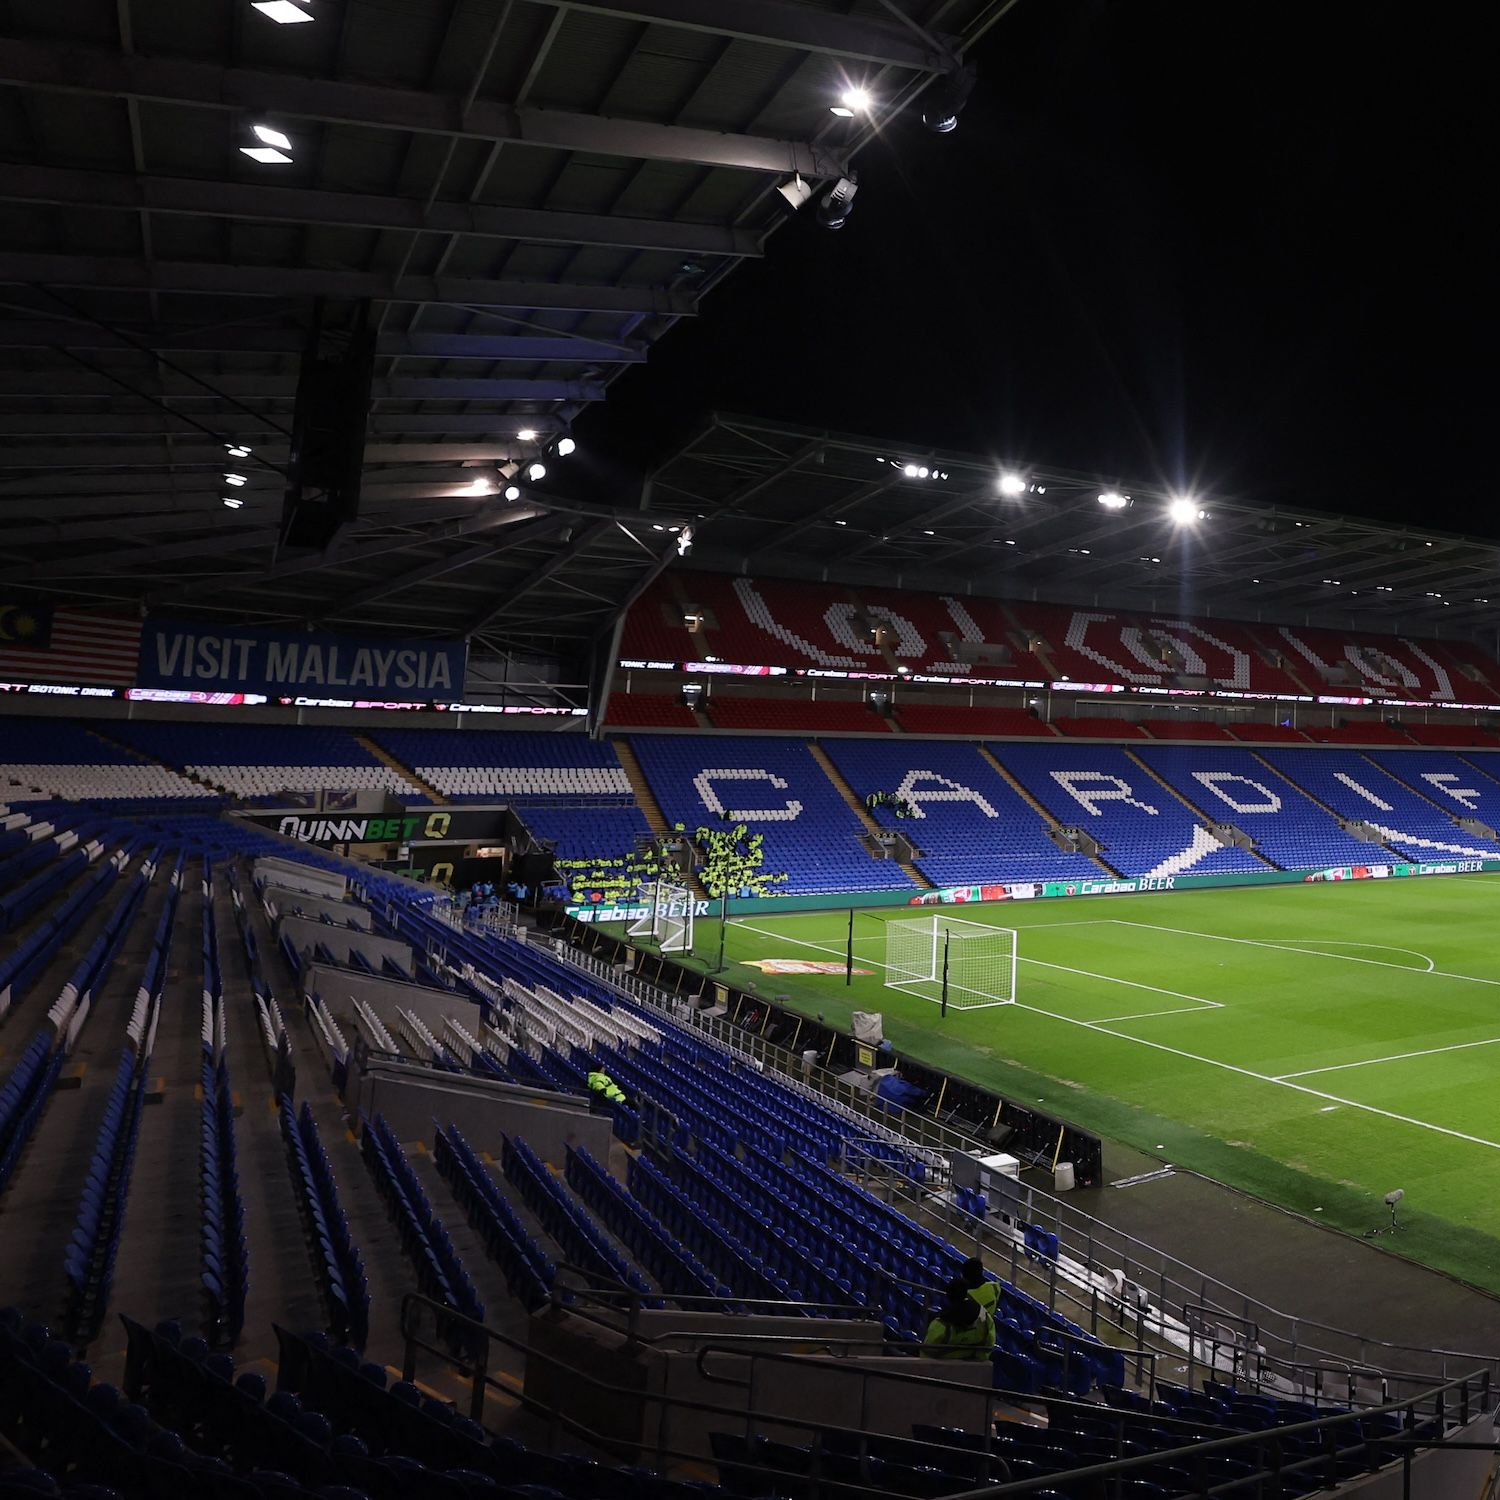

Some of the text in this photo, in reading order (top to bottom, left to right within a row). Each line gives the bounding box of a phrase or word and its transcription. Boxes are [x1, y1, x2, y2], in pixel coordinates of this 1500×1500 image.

[156, 632, 452, 690] VISIT MALAYSIA
[807, 669, 848, 677] Carabao
[28, 685, 79, 695] ISOTONIC
[81, 688, 115, 696] DRINK
[295, 697, 426, 709] Carabao SPORT
[449, 704, 503, 712] Carabao
[278, 816, 421, 842] QUINNBET
[1419, 861, 1483, 874] Carabao BEER
[1081, 878, 1175, 895] Carabao BEER
